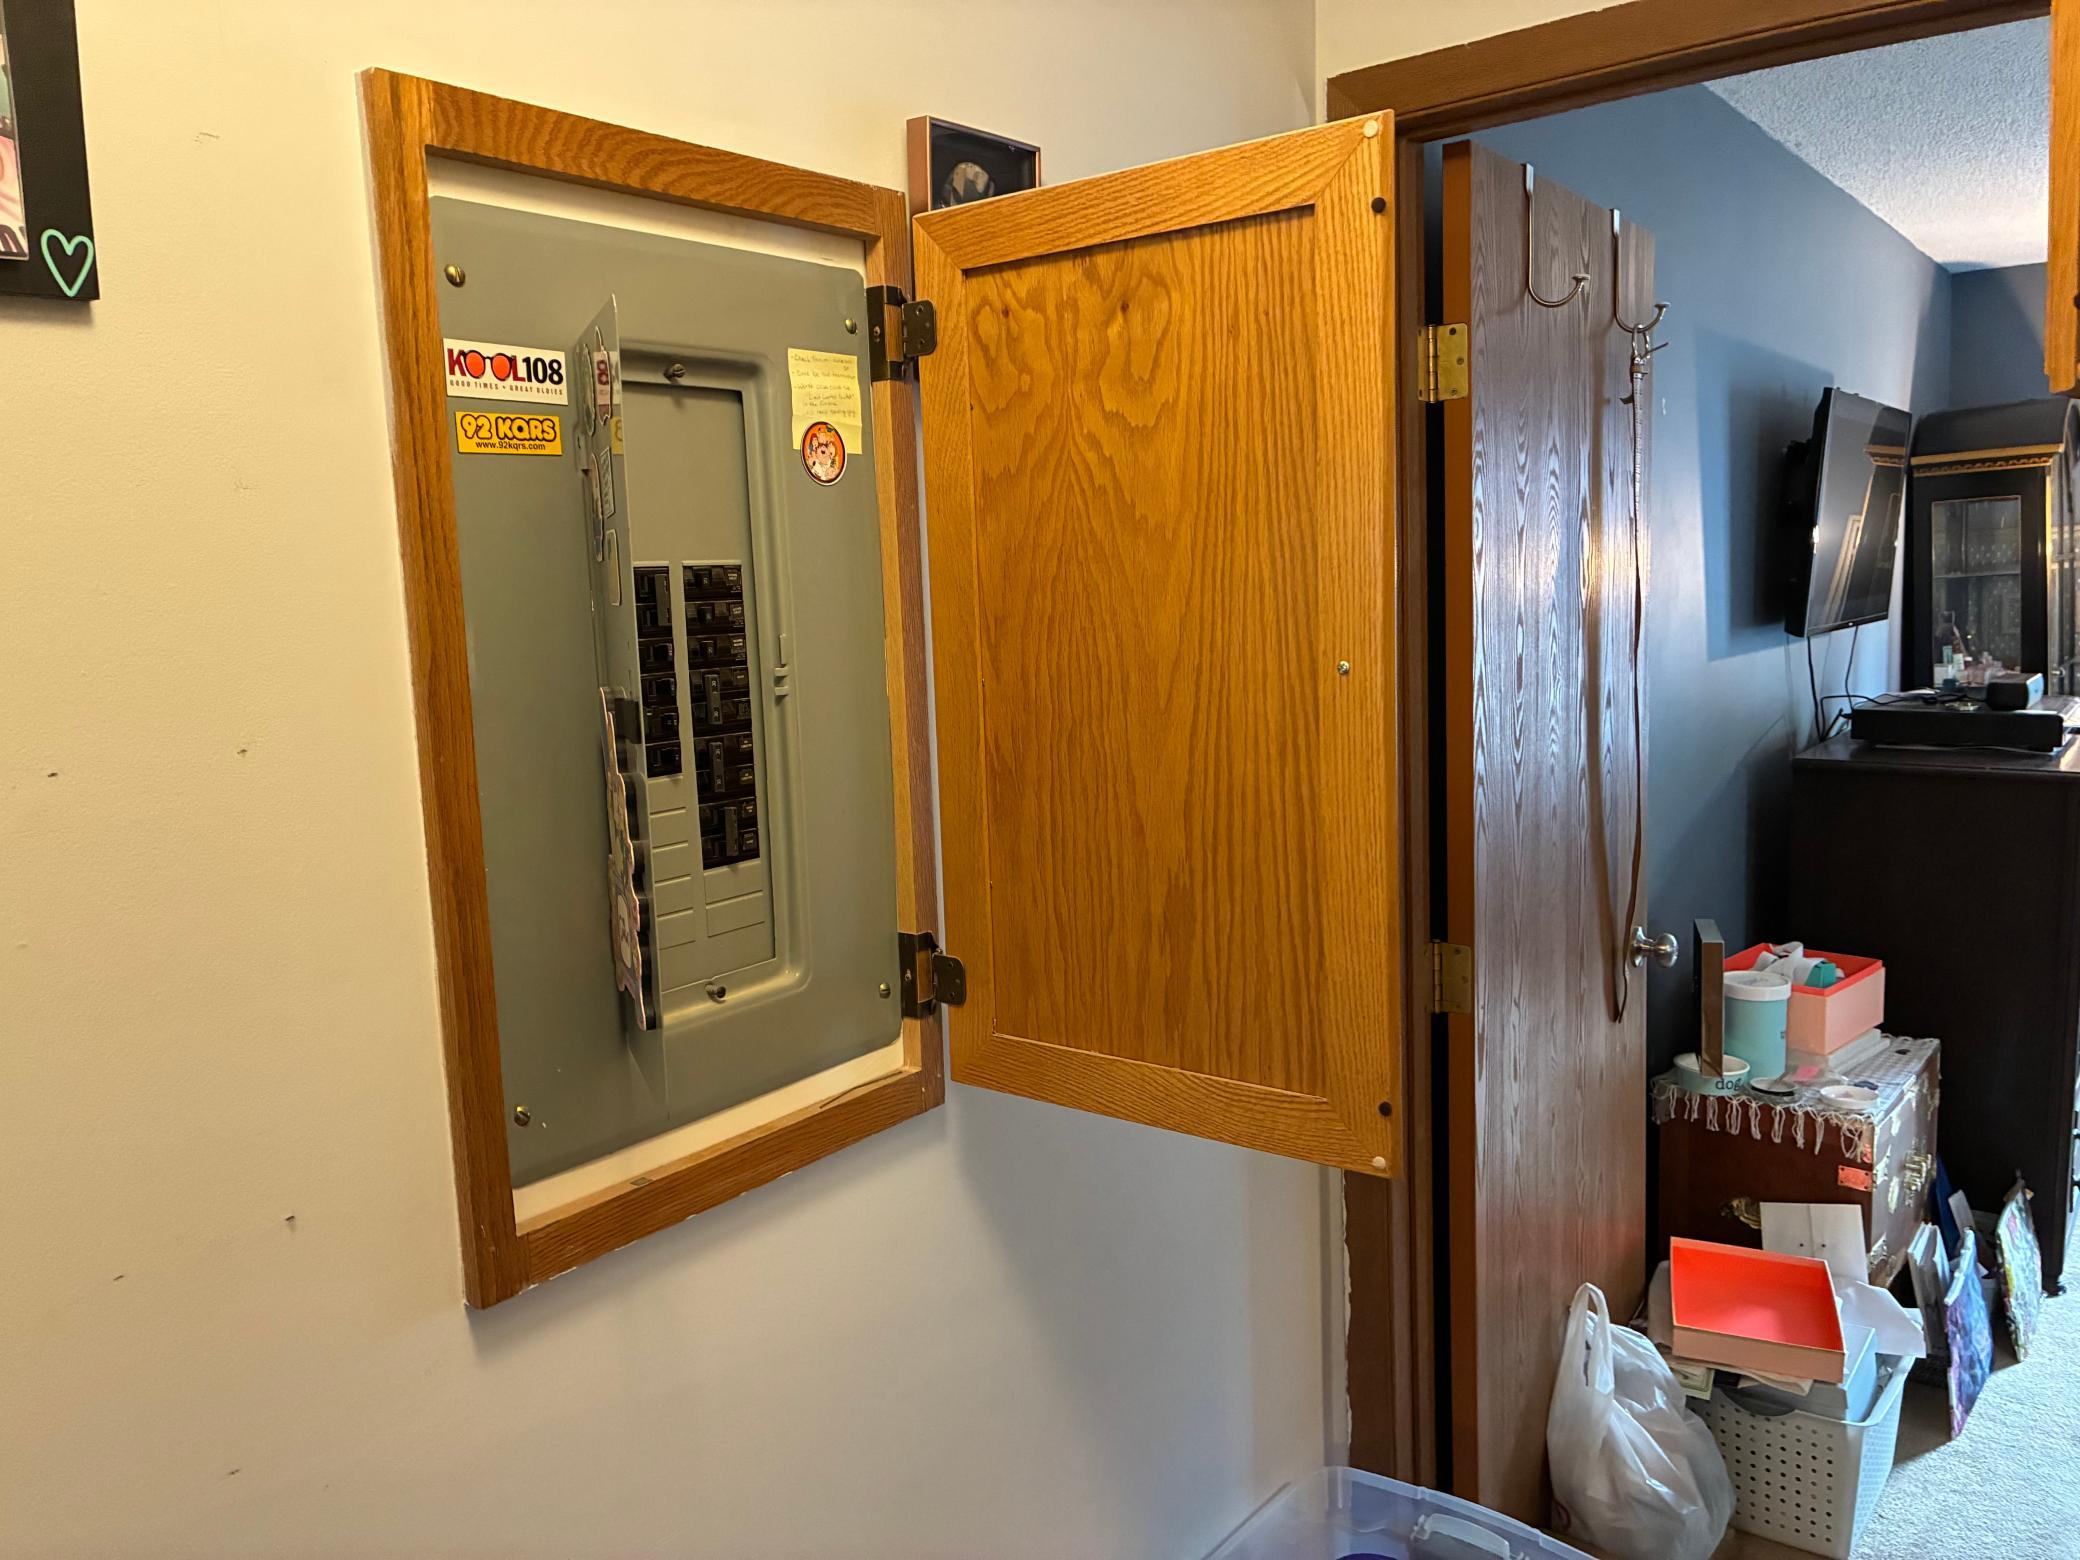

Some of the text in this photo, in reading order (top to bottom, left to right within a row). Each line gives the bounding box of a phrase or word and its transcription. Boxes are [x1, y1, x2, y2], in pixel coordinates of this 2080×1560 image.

[450, 379, 563, 396] GOOD TIMES GREAT OLDIES
[461, 414, 557, 442] 92 KQRS
[475, 440, 546, 452] www.92kqrs.com
[1715, 1077, 1742, 1091] dog
